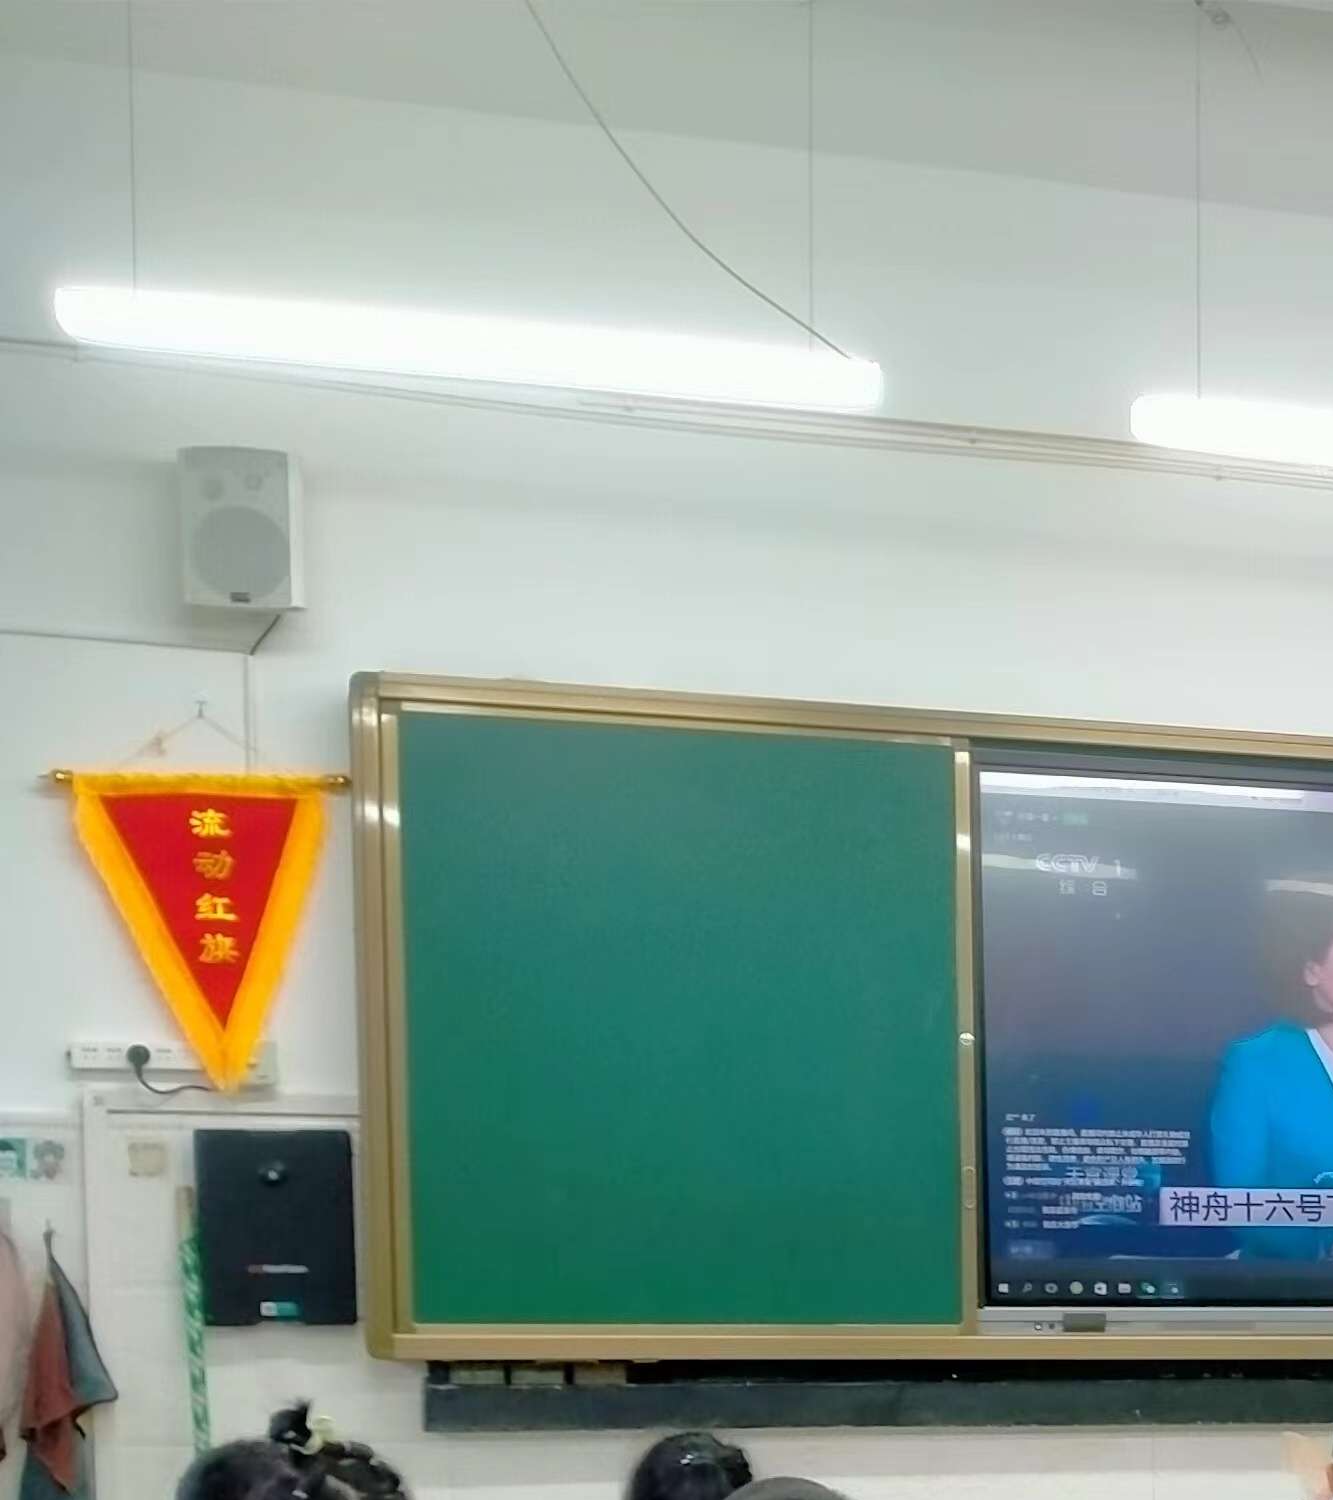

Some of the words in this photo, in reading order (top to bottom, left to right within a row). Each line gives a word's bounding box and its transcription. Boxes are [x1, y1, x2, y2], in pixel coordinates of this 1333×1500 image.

[189, 808, 240, 963] 流动红旗
[1035, 853, 1100, 873] CCTV
